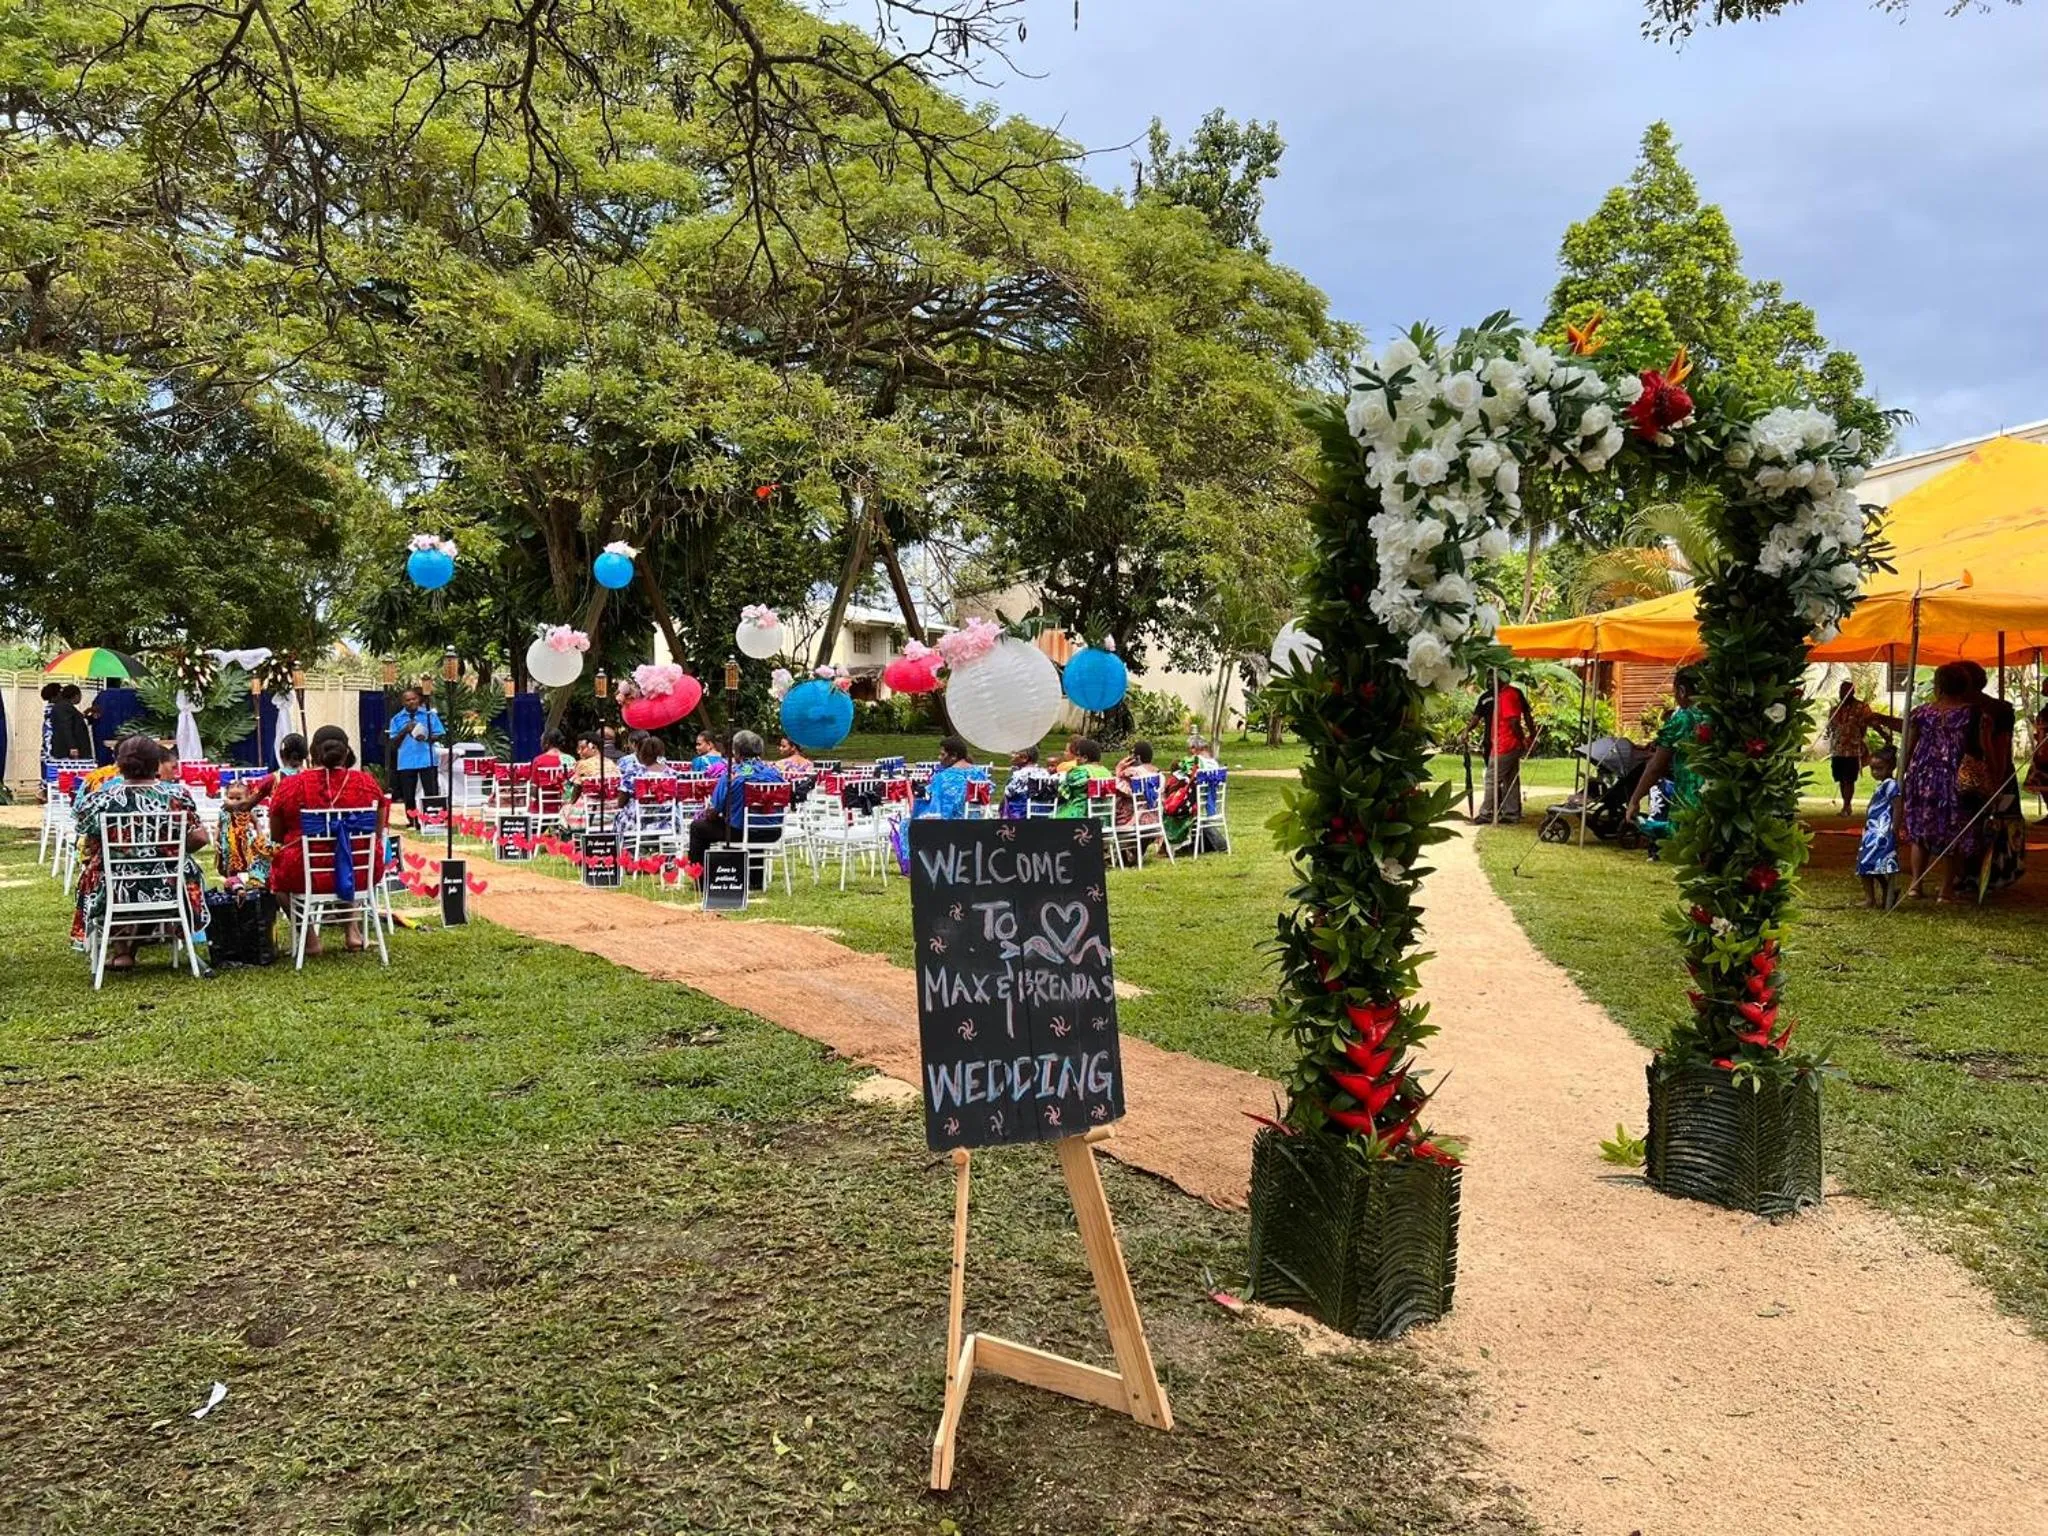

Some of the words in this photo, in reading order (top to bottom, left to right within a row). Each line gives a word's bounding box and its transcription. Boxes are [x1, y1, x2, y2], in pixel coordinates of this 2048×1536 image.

[918, 841, 1073, 889] WELCOME
[925, 965, 991, 1012] MAX
[928, 1050, 1113, 1113] WEDDING
